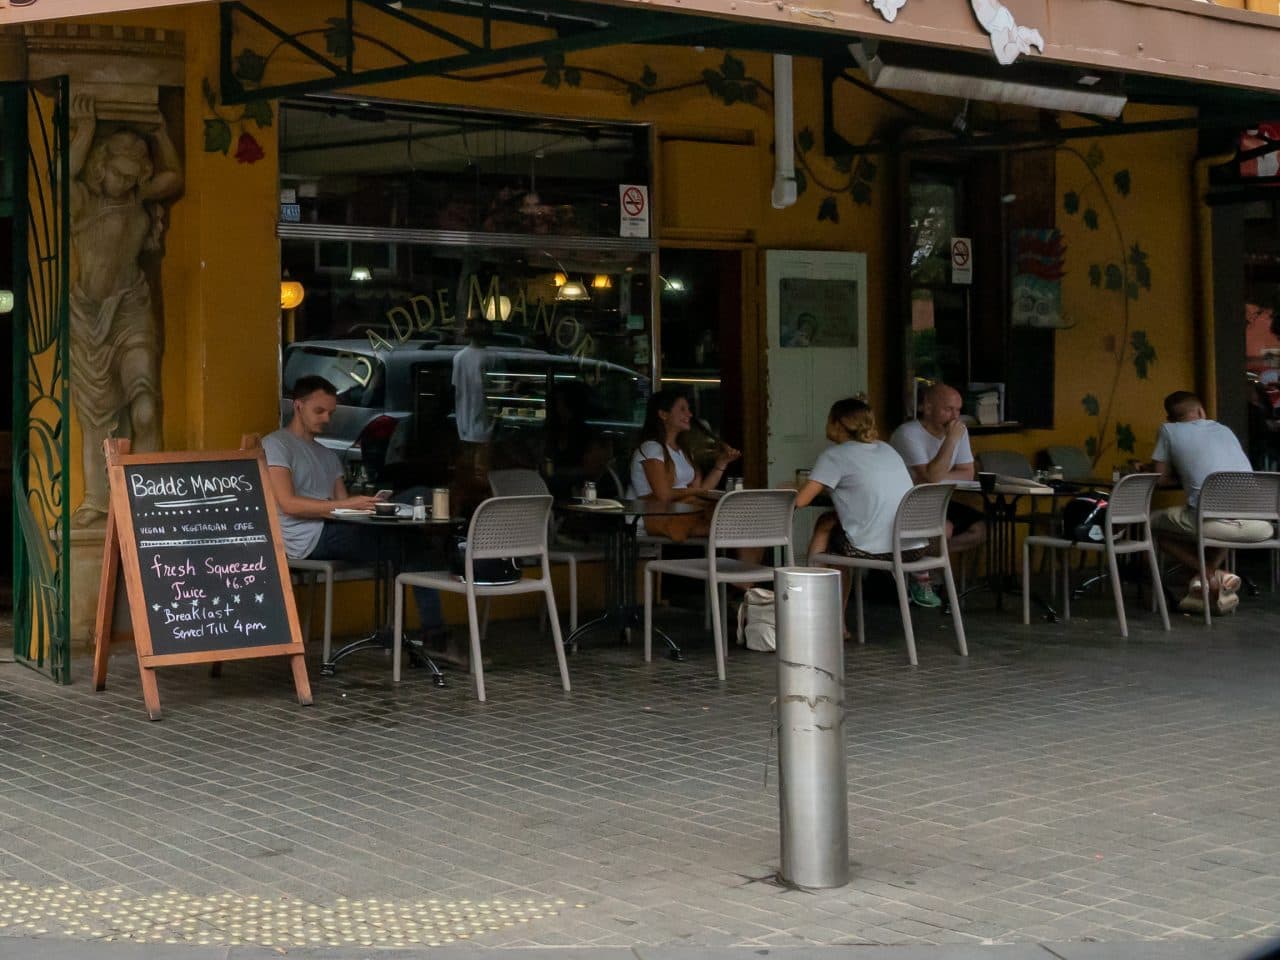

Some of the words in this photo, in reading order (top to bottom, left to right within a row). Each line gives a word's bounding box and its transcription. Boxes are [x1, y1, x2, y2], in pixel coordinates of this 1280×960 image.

[140, 526, 165, 534] VEGAN
[205, 556, 267, 579] Squeezed
[171, 581, 207, 600] Juice
[172, 626, 204, 639] Served
[206, 622, 229, 635] Till
